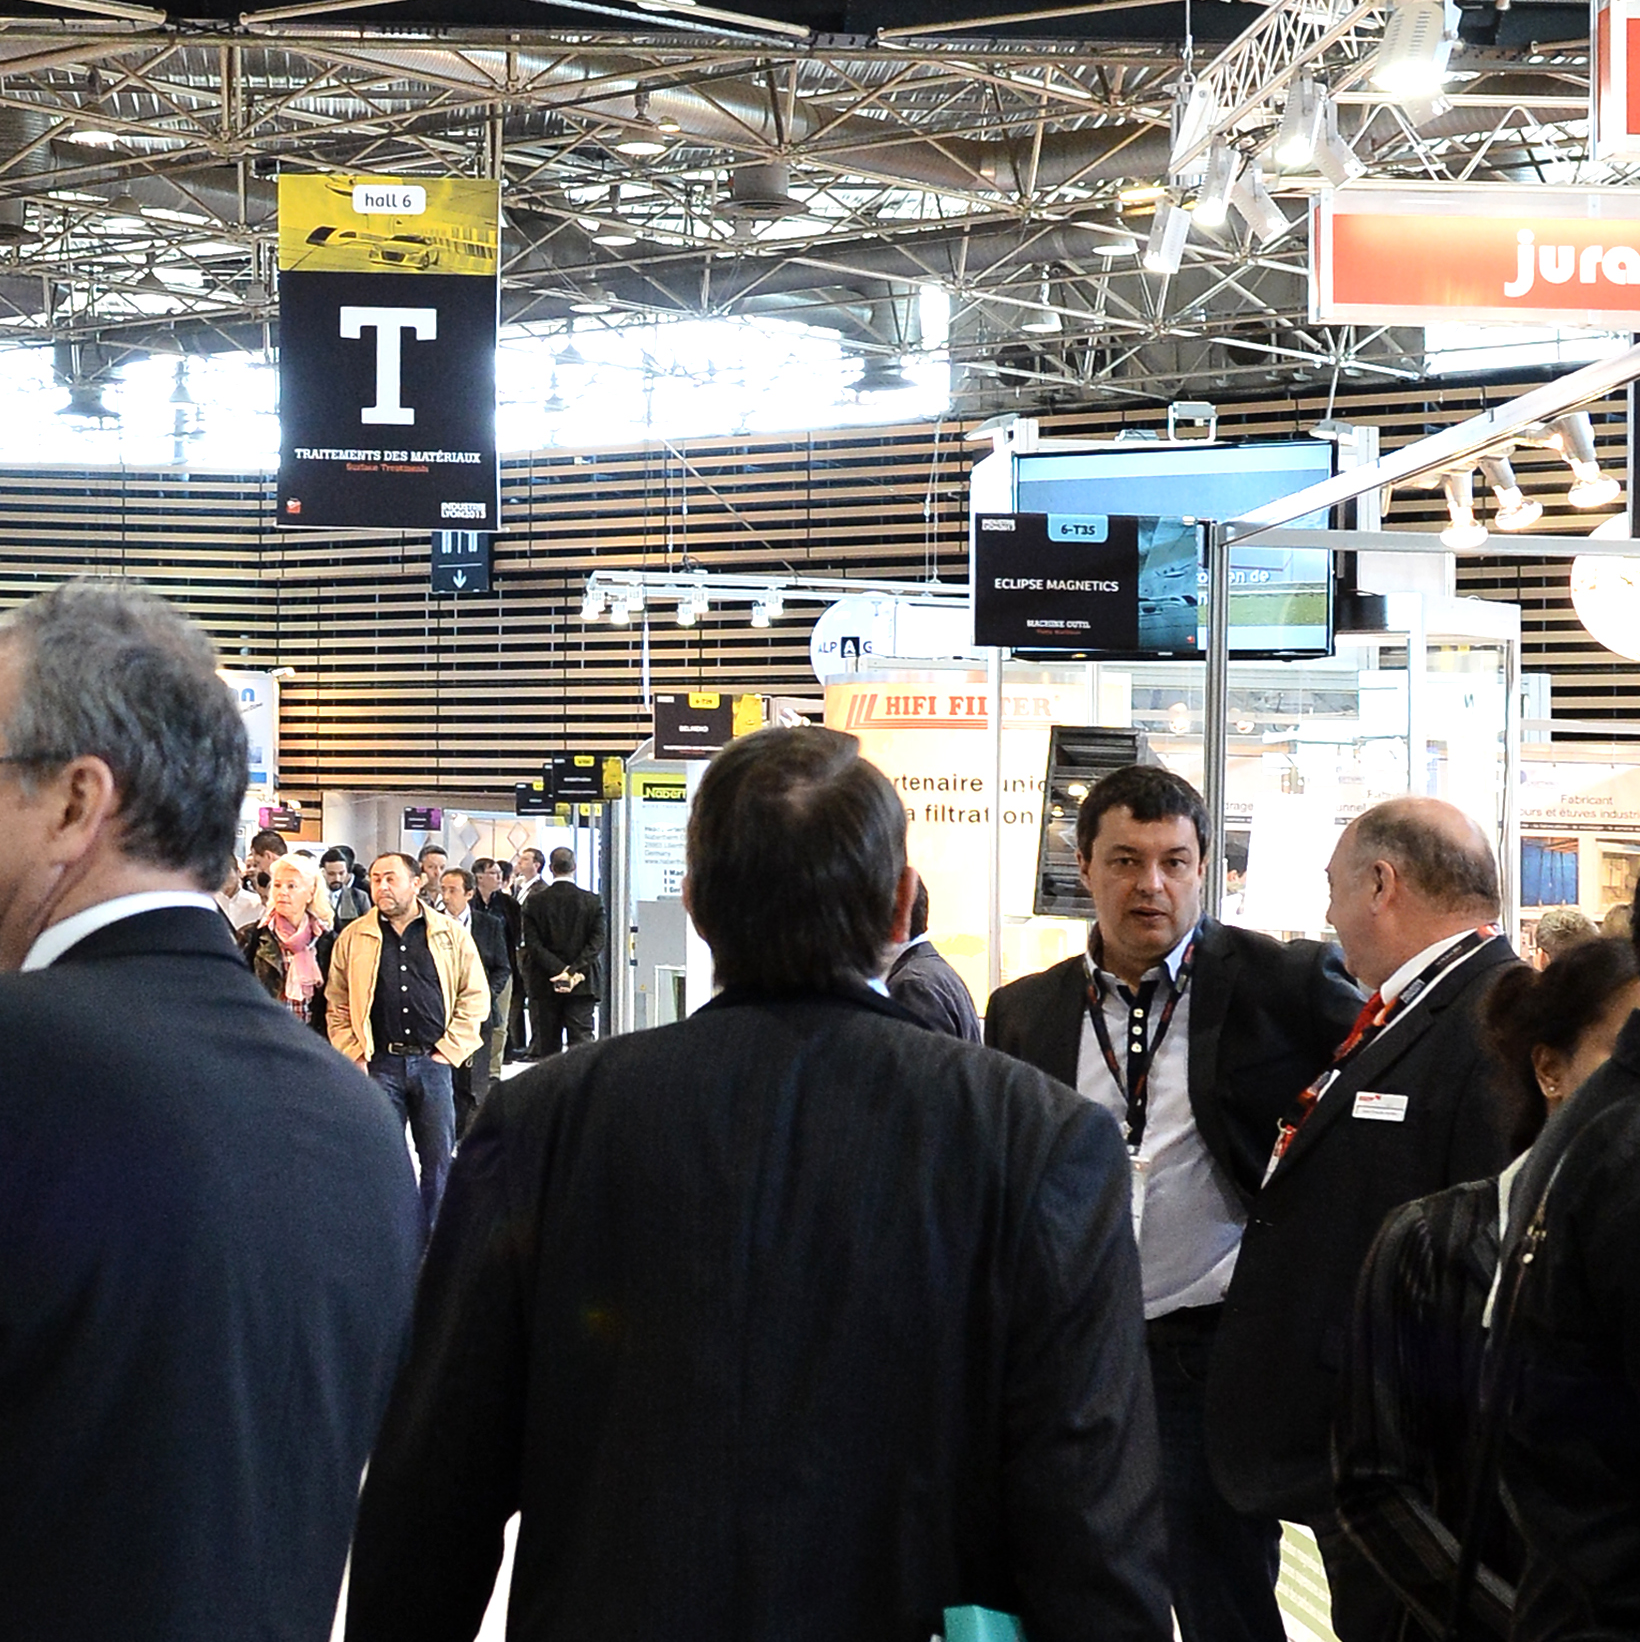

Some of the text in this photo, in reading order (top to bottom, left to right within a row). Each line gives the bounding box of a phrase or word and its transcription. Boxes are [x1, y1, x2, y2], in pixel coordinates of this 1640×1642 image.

[365, 193, 412, 208] hall 6
[1504, 228, 1640, 297] jura
[340, 306, 437, 425] T
[294, 448, 481, 463] TRAITEMENTS DES MATÉRIAUX
[994, 578, 1119, 592] ECLIPSE MAGNETICS
[885, 696, 936, 715] HIFI
[894, 774, 983, 792] rtenaire
[1561, 795, 1613, 805] Fabricant
[926, 805, 1033, 824] filtraton
